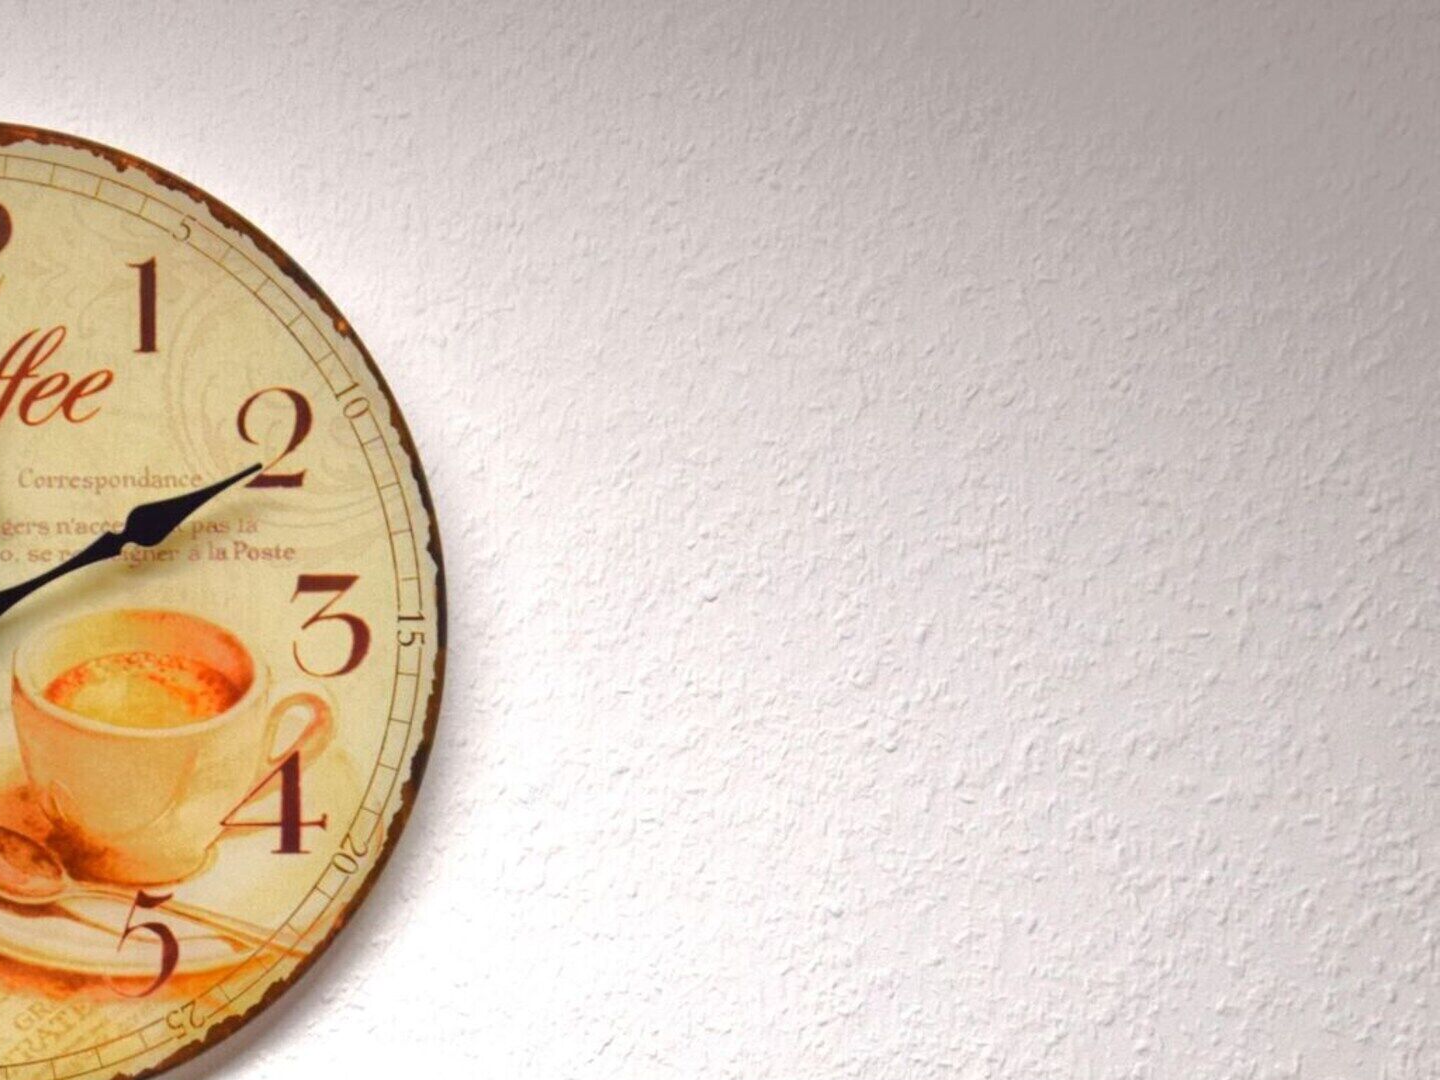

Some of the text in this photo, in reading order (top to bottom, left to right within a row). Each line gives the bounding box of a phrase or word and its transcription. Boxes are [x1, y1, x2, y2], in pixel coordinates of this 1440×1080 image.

[171, 214, 197, 242] 5
[126, 256, 159, 353] 1
[335, 381, 370, 420] 10
[236, 387, 313, 489] 2
[18, 467, 203, 491] Correspondance
[27, 548, 53, 563] se
[233, 540, 296, 561] Poste
[290, 574, 372, 678] 3
[396, 611, 426, 647] 15
[220, 750, 328, 854] 4
[331, 833, 369, 876] 20
[103, 889, 180, 998] 5
[166, 1000, 207, 1040] 25
